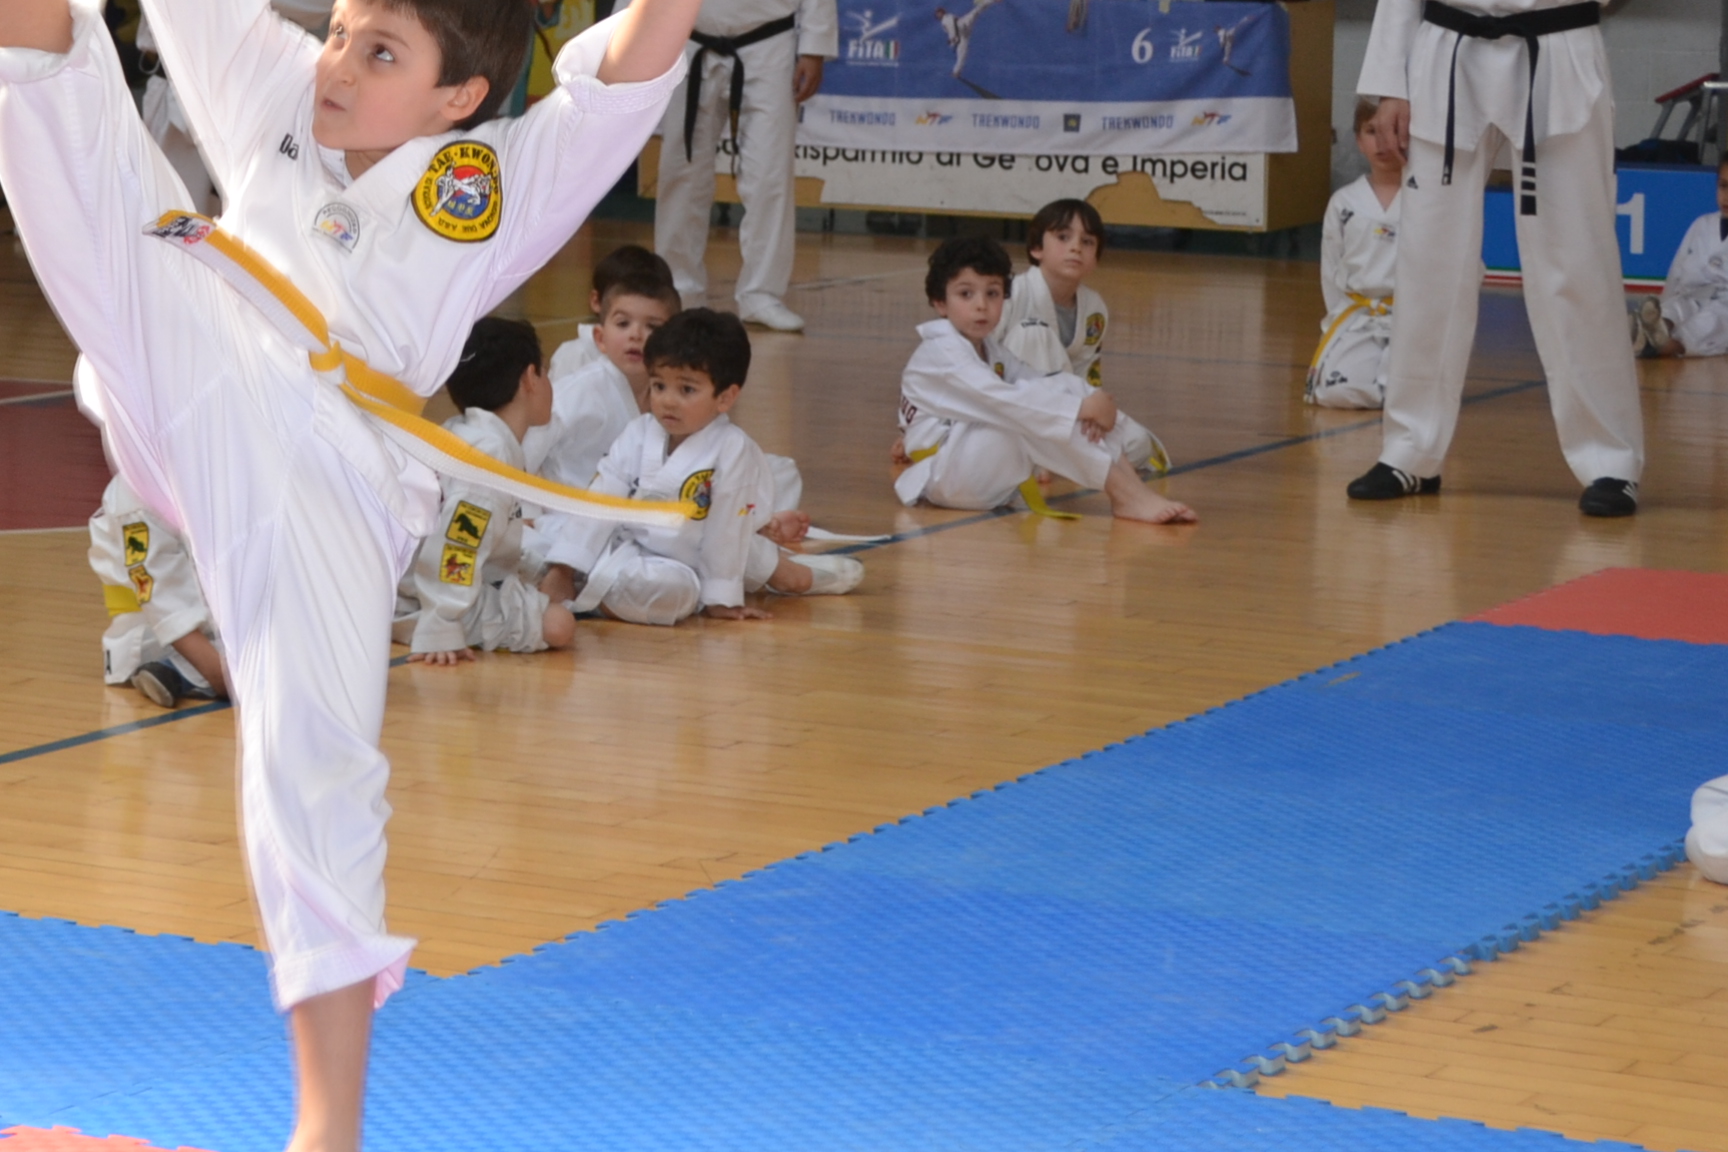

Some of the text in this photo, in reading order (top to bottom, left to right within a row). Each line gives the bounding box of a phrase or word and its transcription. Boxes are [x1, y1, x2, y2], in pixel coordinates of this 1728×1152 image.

[1131, 28, 1154, 64] 6
[1101, 155, 1119, 176] e
[1616, 192, 1645, 255] 1
